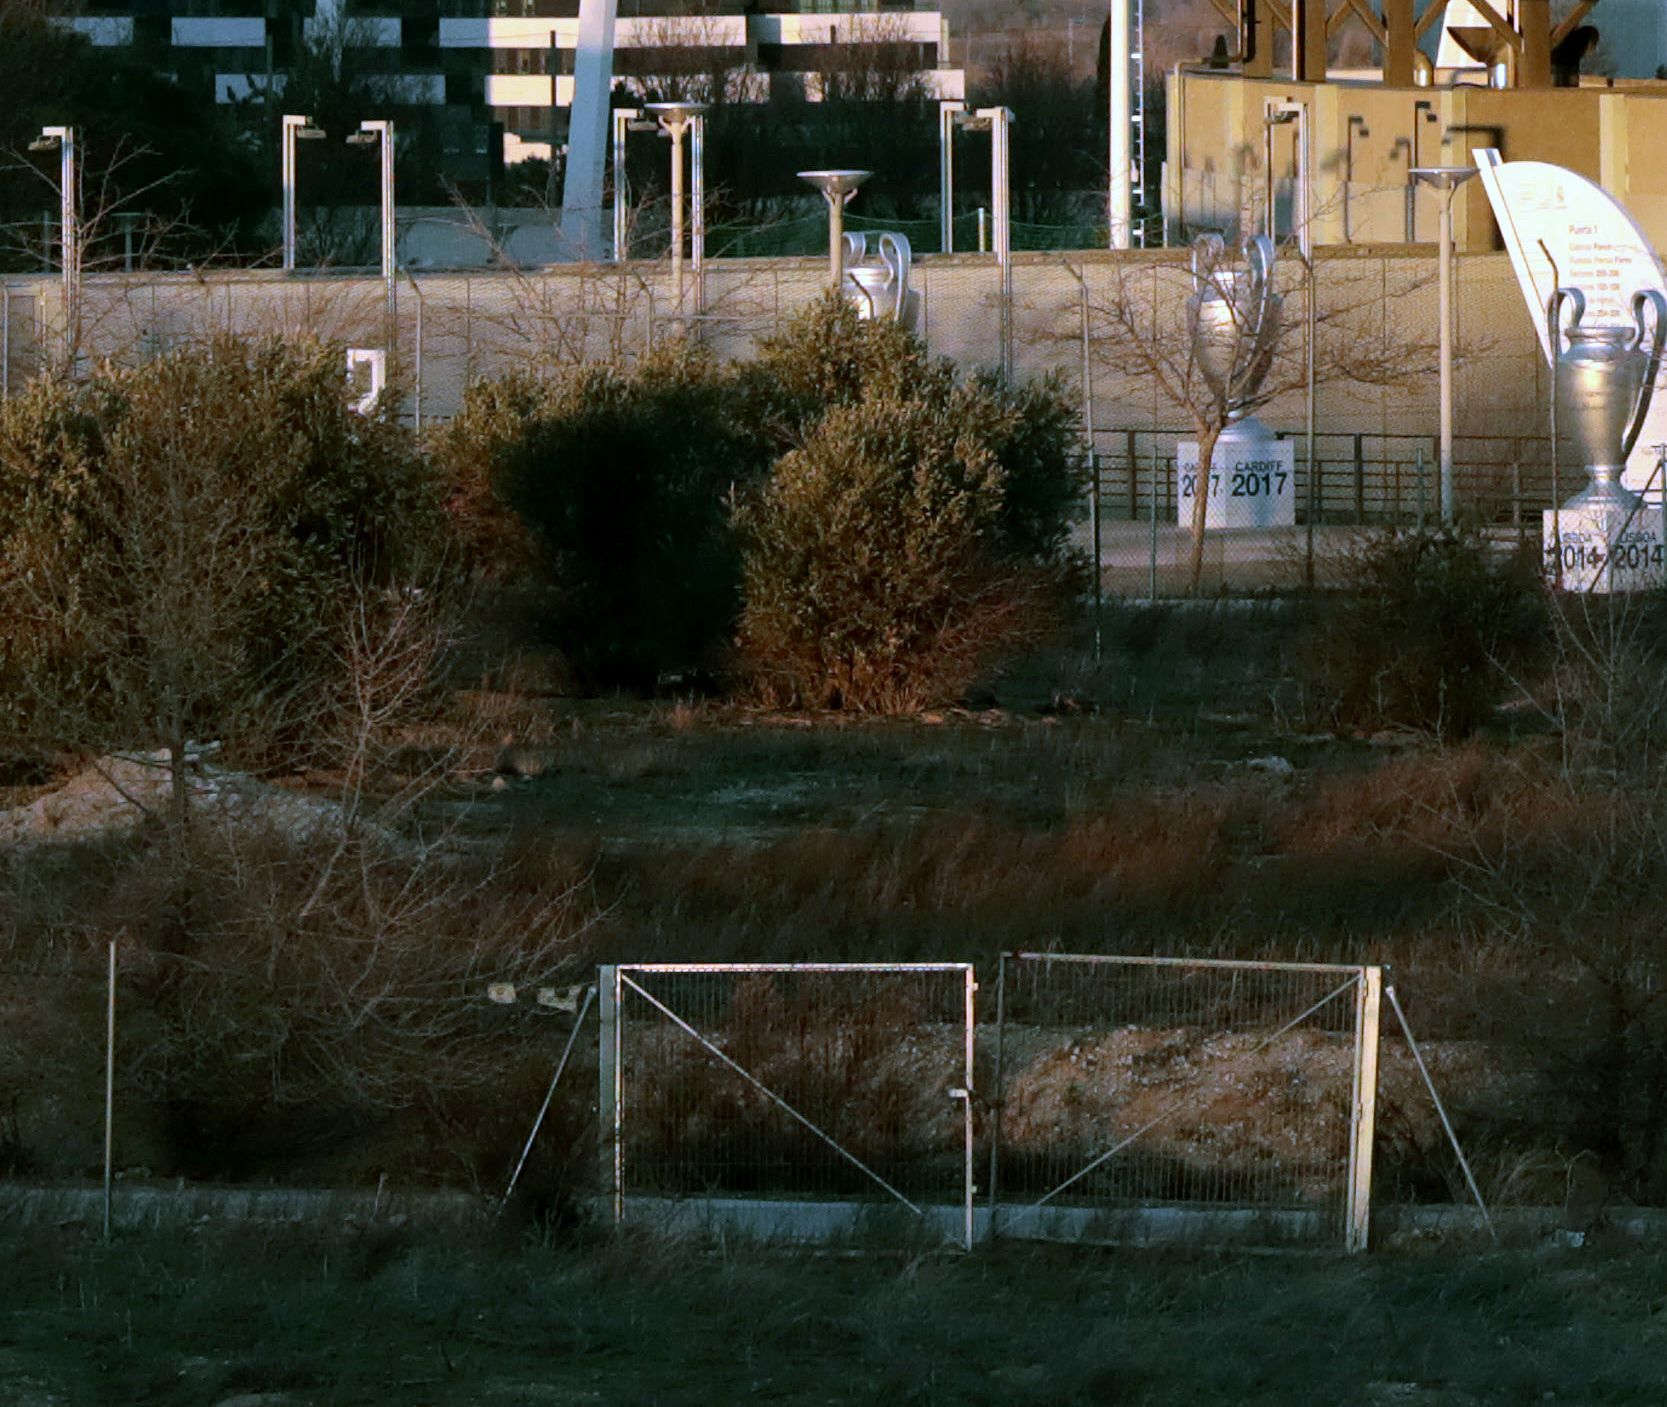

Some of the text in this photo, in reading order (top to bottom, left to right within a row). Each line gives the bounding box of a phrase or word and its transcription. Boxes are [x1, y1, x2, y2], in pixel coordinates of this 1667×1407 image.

[1235, 461, 1283, 472] CARDIFF
[1182, 474, 1221, 498] 207
[1231, 472, 1288, 497] 2017
[1553, 545, 1600, 570] 014
[1614, 544, 1665, 569] 2014
